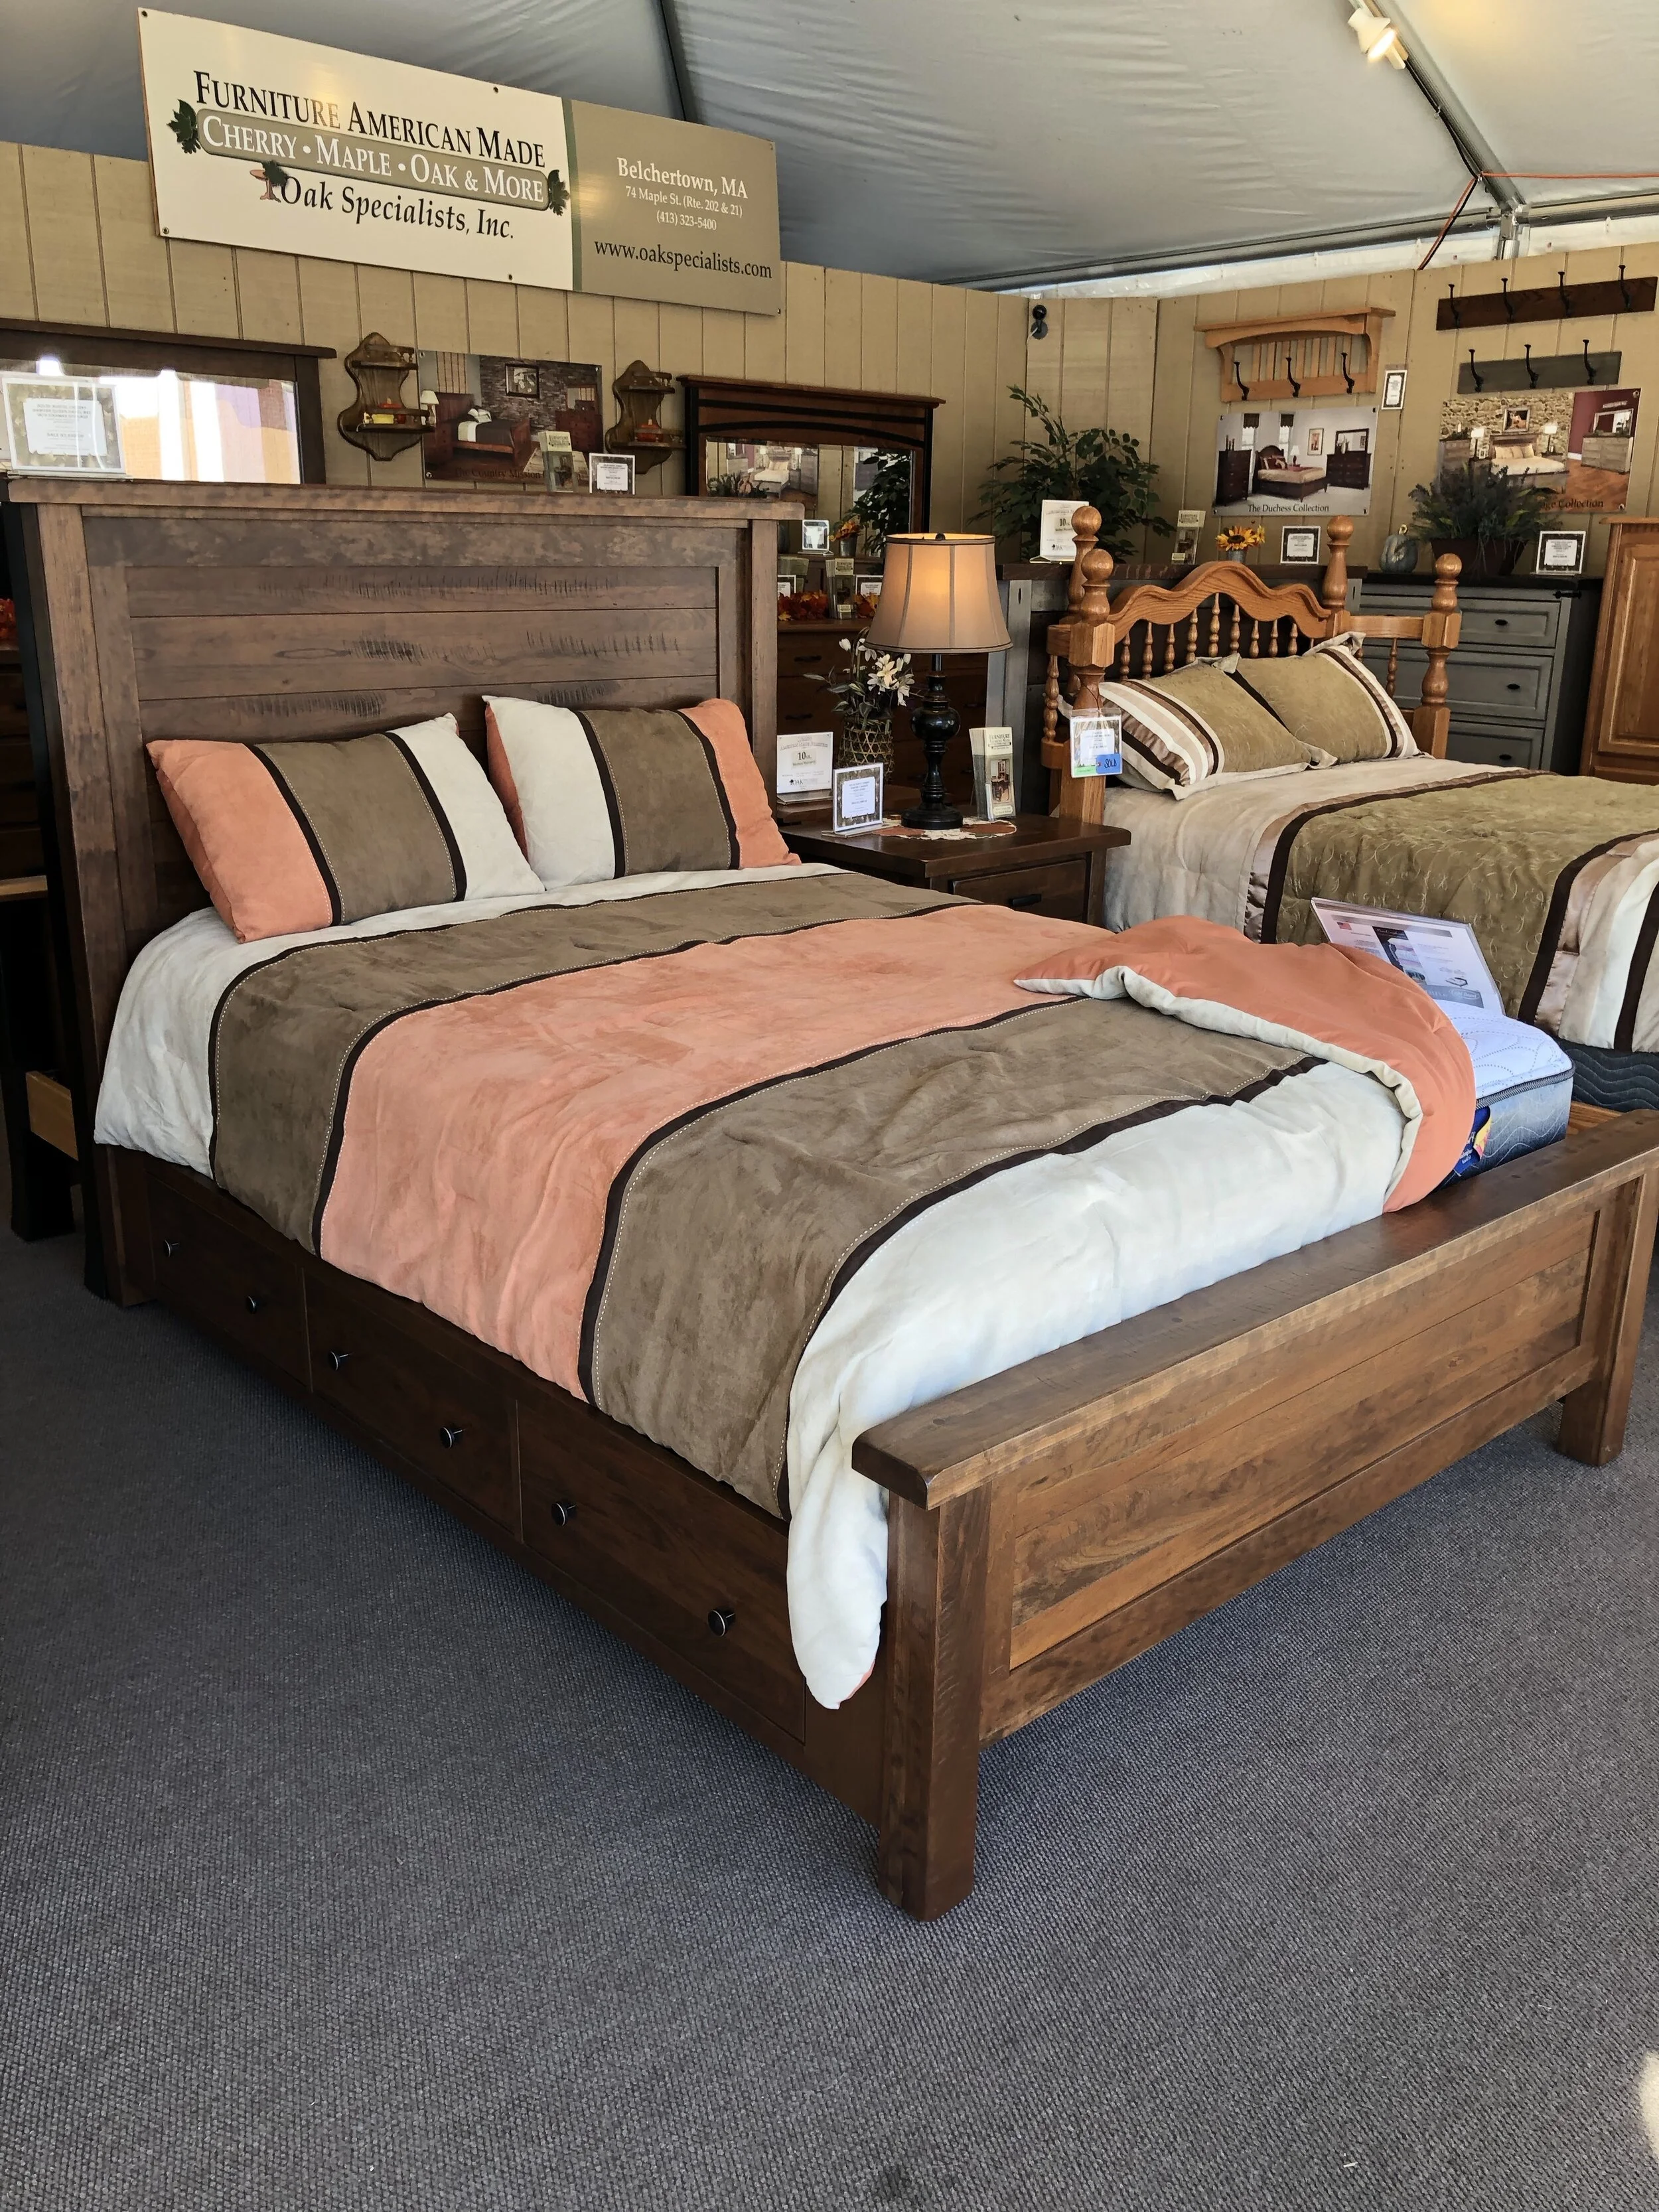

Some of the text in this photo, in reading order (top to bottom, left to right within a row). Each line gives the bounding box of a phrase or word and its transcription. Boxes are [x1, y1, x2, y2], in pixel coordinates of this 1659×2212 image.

[194, 70, 545, 168] FURNITURE AMERICAN MADE
[202, 115, 544, 203] CHERRY MAPLE OAK & MORE
[616, 157, 749, 199] Belchertown, MA
[281, 176, 514, 239] Oak Specialists, Inc.
[626, 185, 742, 218] 74 Maple St. (Rte. 202 & 21)
[656, 210, 717, 230] (413) 323-5400
[595, 240, 772, 279] www.oakspecialists.com
[471, 469, 506, 480] Country
[1248, 504, 1330, 512] The Duchess Collection
[1558, 498, 1604, 508] Collection
[798, 751, 806, 761] 10
[1104, 759, 1118, 769] SOLD
